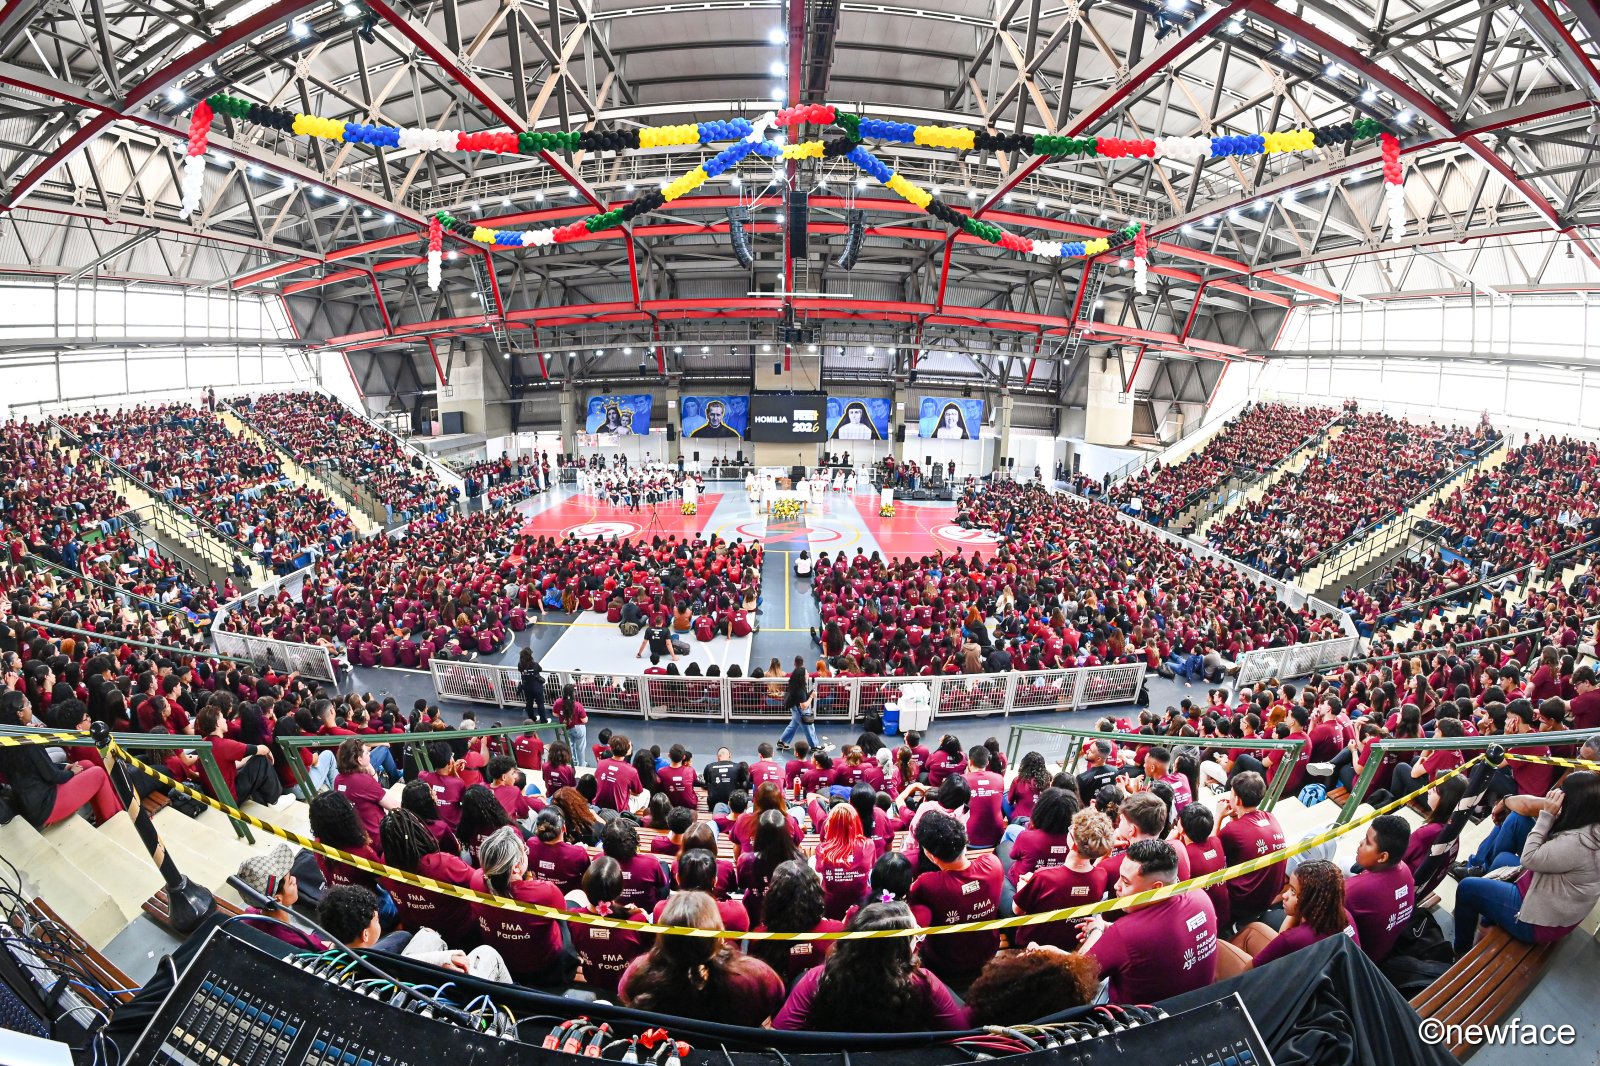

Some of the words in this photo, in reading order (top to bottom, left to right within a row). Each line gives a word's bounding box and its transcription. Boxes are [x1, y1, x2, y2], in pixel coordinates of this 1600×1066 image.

[754, 415, 788, 424] HOMILIA
[792, 422, 820, 433] 2026
[407, 893, 426, 902] FMA
[406, 902, 436, 910] Paraná
[973, 898, 992, 911] FMA
[966, 903, 996, 921] Paraná
[501, 922, 523, 932] FMA
[496, 930, 531, 940] Paraná
[1195, 929, 1208, 942] SDB
[602, 954, 624, 962] FMA
[597, 960, 630, 971] Paraná
